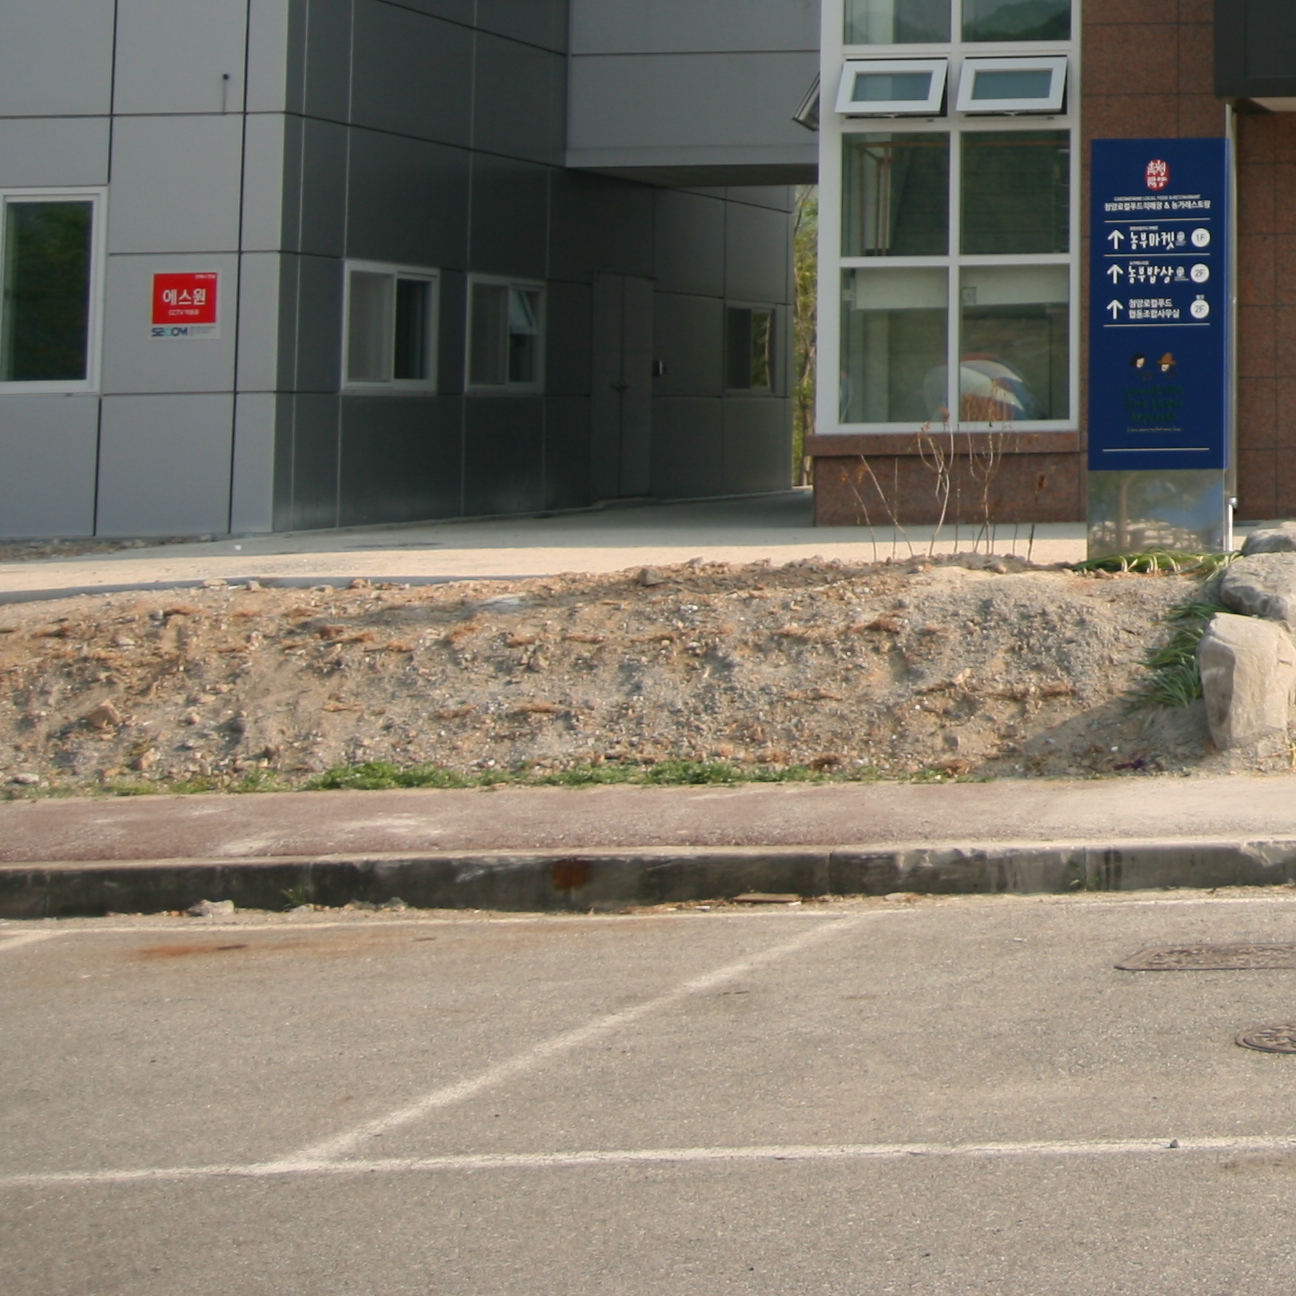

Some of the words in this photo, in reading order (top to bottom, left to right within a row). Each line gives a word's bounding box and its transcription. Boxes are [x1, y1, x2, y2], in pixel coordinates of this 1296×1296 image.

[1130, 231, 1175, 250] 농부마켓
[1128, 266, 1174, 284] 농부밥상
[162, 288, 206, 306] 에스원
